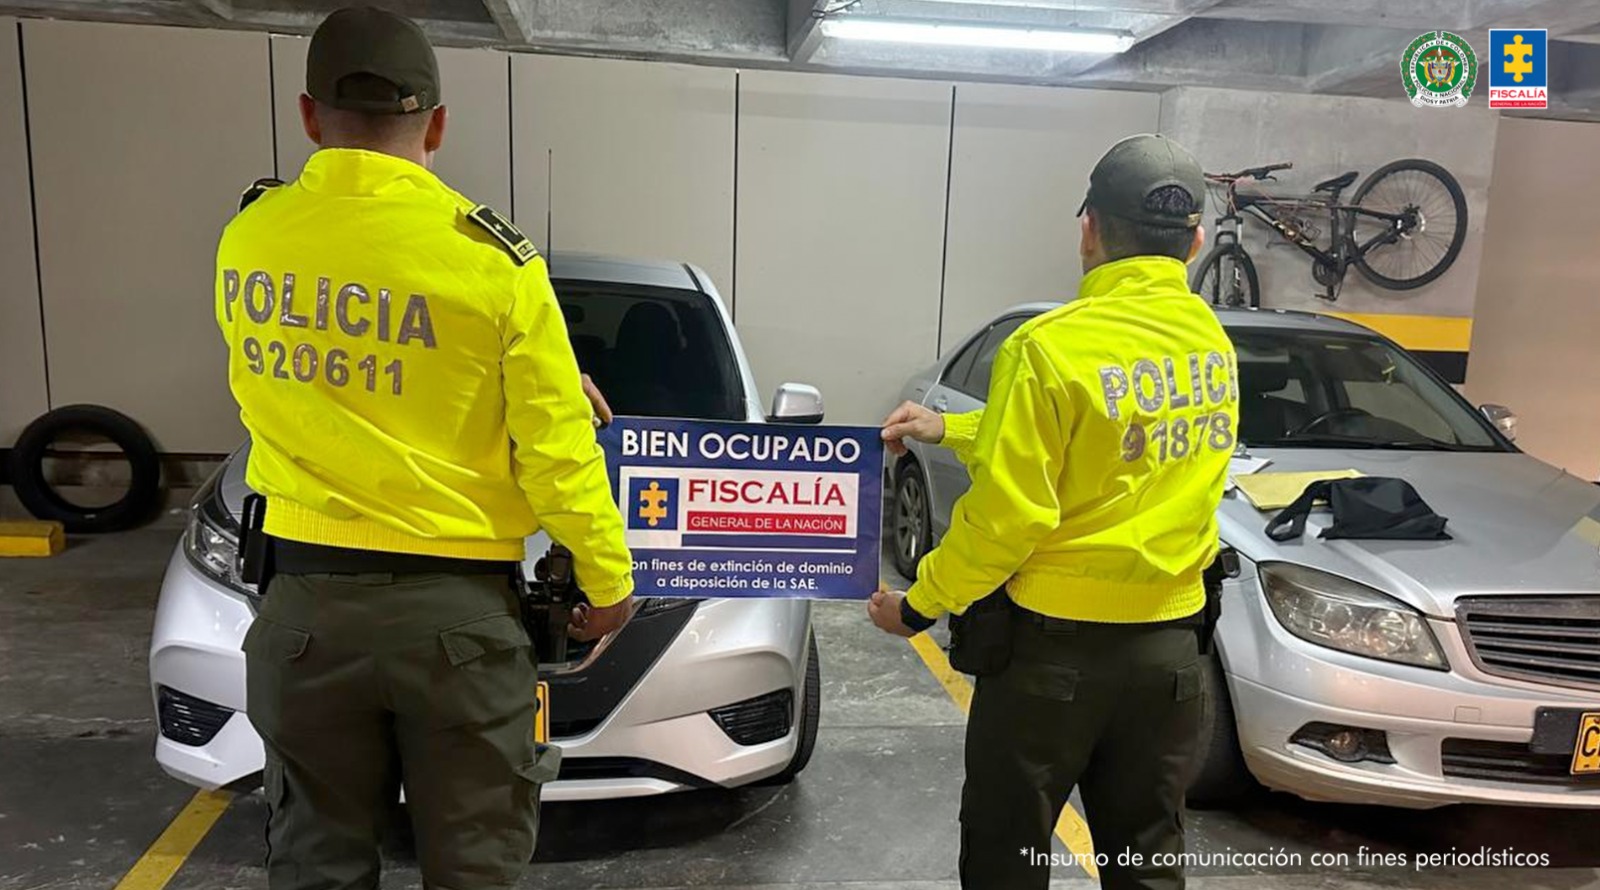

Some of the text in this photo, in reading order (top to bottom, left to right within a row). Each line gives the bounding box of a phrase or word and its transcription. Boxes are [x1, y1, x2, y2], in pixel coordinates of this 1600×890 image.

[222, 268, 438, 349] POLICIA
[243, 336, 403, 396] 920611
[622, 429, 861, 464] BIEN OCUPADO
[688, 477, 846, 506] FISCALÍA
[691, 516, 843, 531] GENERAL DE LA NACIÓN
[651, 559, 683, 572] fines
[688, 559, 706, 572] de
[710, 560, 771, 573] extinción
[778, 561, 795, 574] de
[800, 561, 853, 575] dominio
[656, 575, 819, 592] a disposición de la SAE.
[1582, 726, 1600, 757] C
